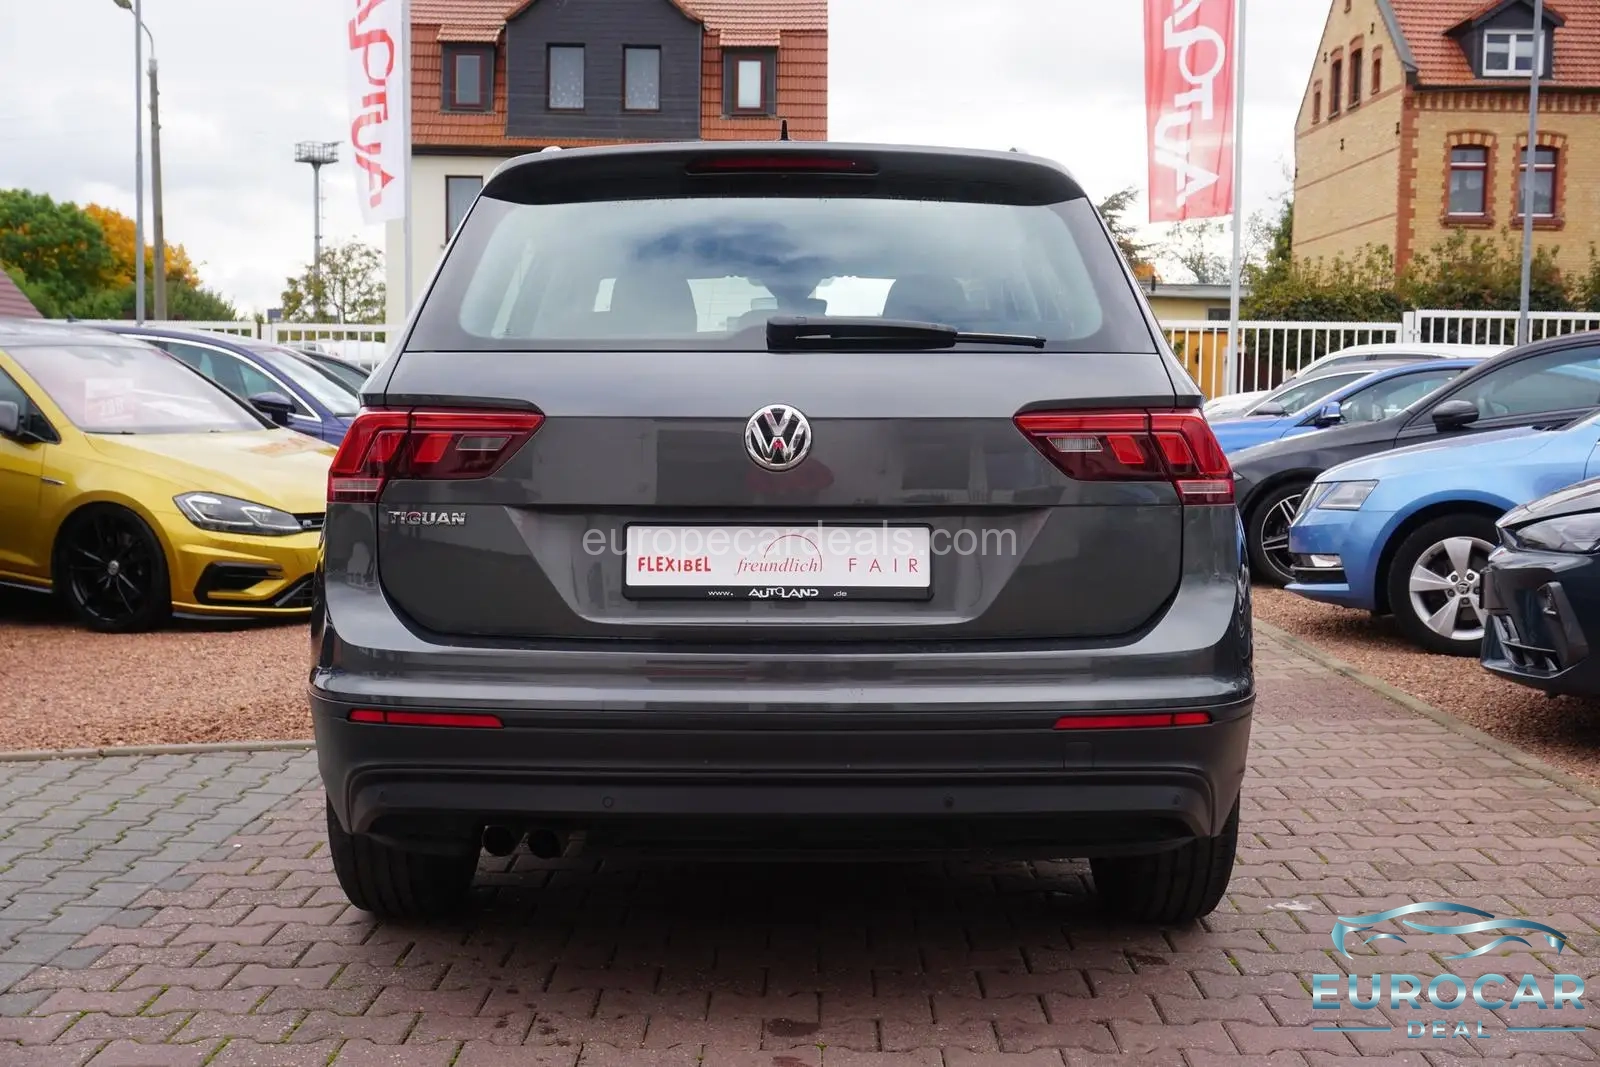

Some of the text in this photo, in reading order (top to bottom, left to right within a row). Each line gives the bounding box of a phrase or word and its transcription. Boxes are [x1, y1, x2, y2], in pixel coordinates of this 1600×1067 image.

[387, 510, 466, 525] TIGUAN
[638, 556, 919, 574] FLEXIBEL freundlich FAIR
[748, 587, 819, 598] AUTOLAND
